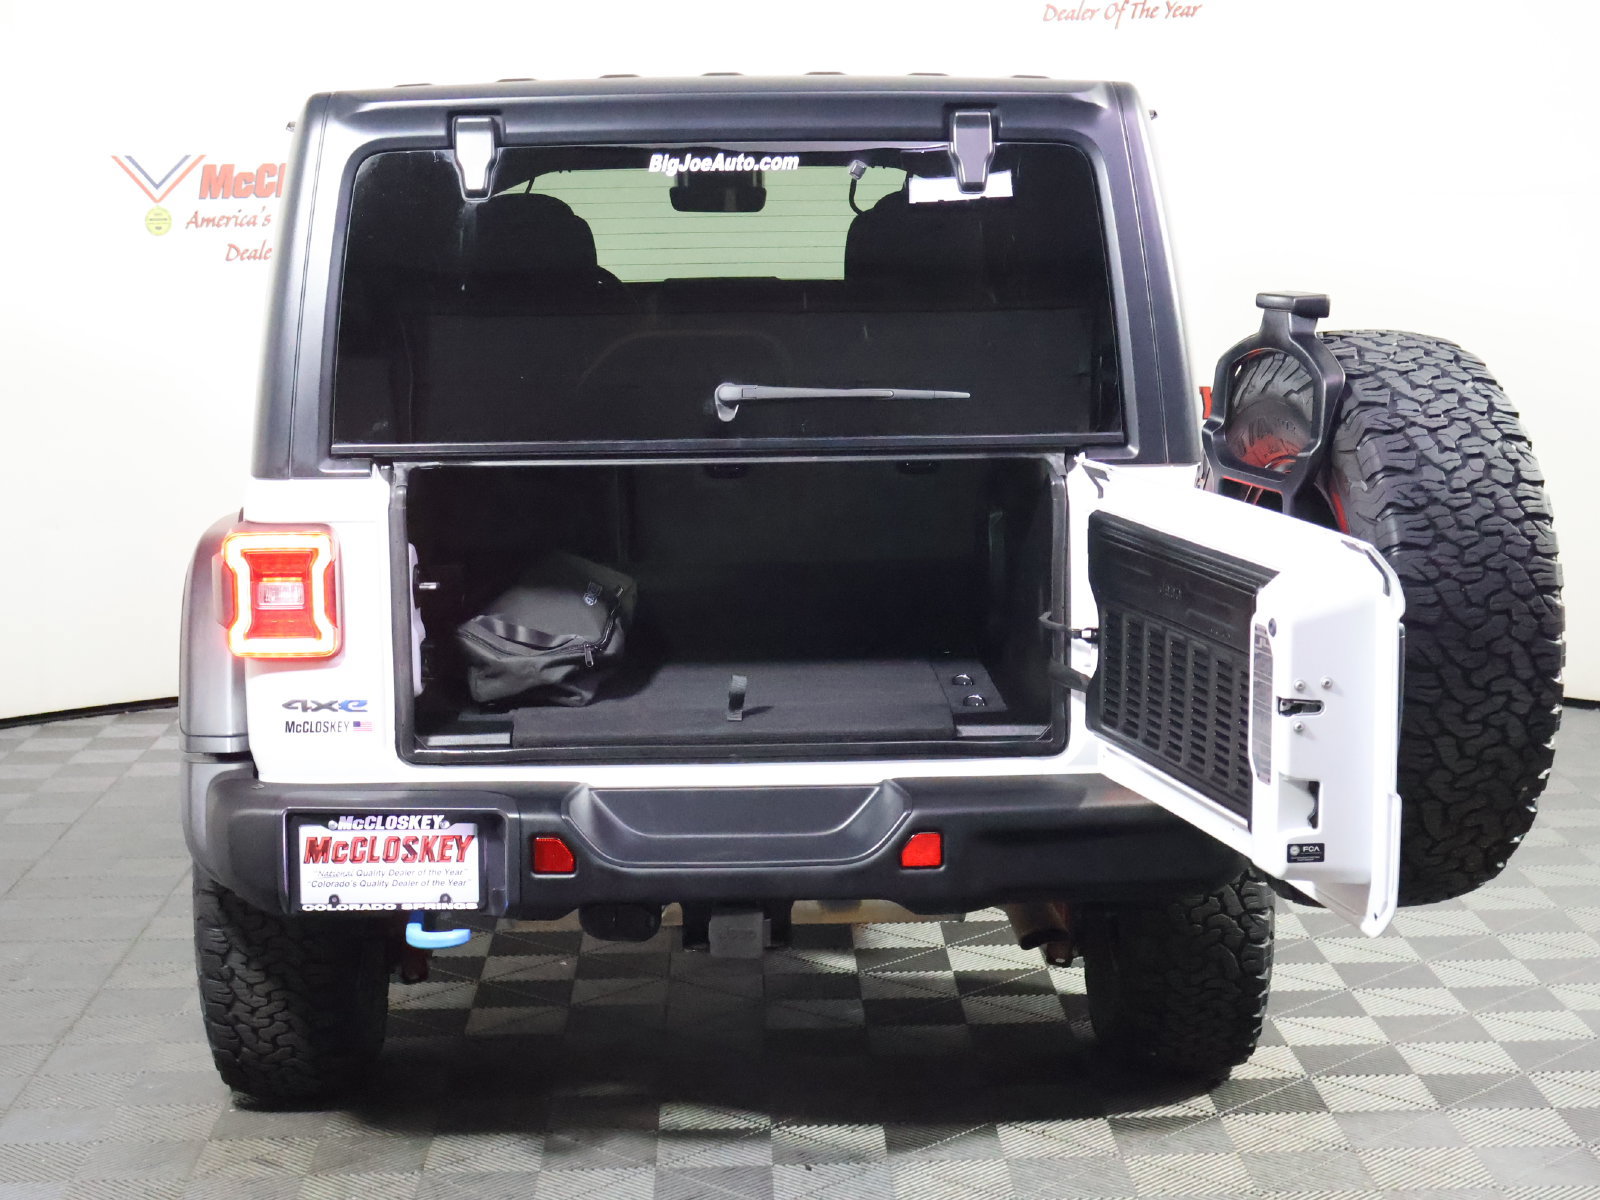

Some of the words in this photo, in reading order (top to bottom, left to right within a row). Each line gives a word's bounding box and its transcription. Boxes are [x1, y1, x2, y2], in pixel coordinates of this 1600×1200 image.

[1043, 0, 1100, 21] Dealer
[1131, 0, 1159, 19] The
[1165, 0, 1202, 19] Year
[648, 153, 799, 176] BigJoeAuto.com
[185, 206, 272, 229] America's
[225, 240, 273, 262] Deale
[285, 721, 349, 733] McCLOSKEY
[337, 815, 444, 830] McCLOSKEY
[303, 835, 475, 864] McCLOSKEY
[1302, 845, 1321, 853] FCA
[356, 868, 386, 878] Quality
[428, 868, 442, 876] the
[359, 880, 389, 889] Quality
[391, 879, 419, 887] Dealer
[421, 879, 430, 887] of
[431, 879, 446, 887] the
[302, 903, 397, 912] COLORADO
[401, 903, 479, 911] SPRINGS
